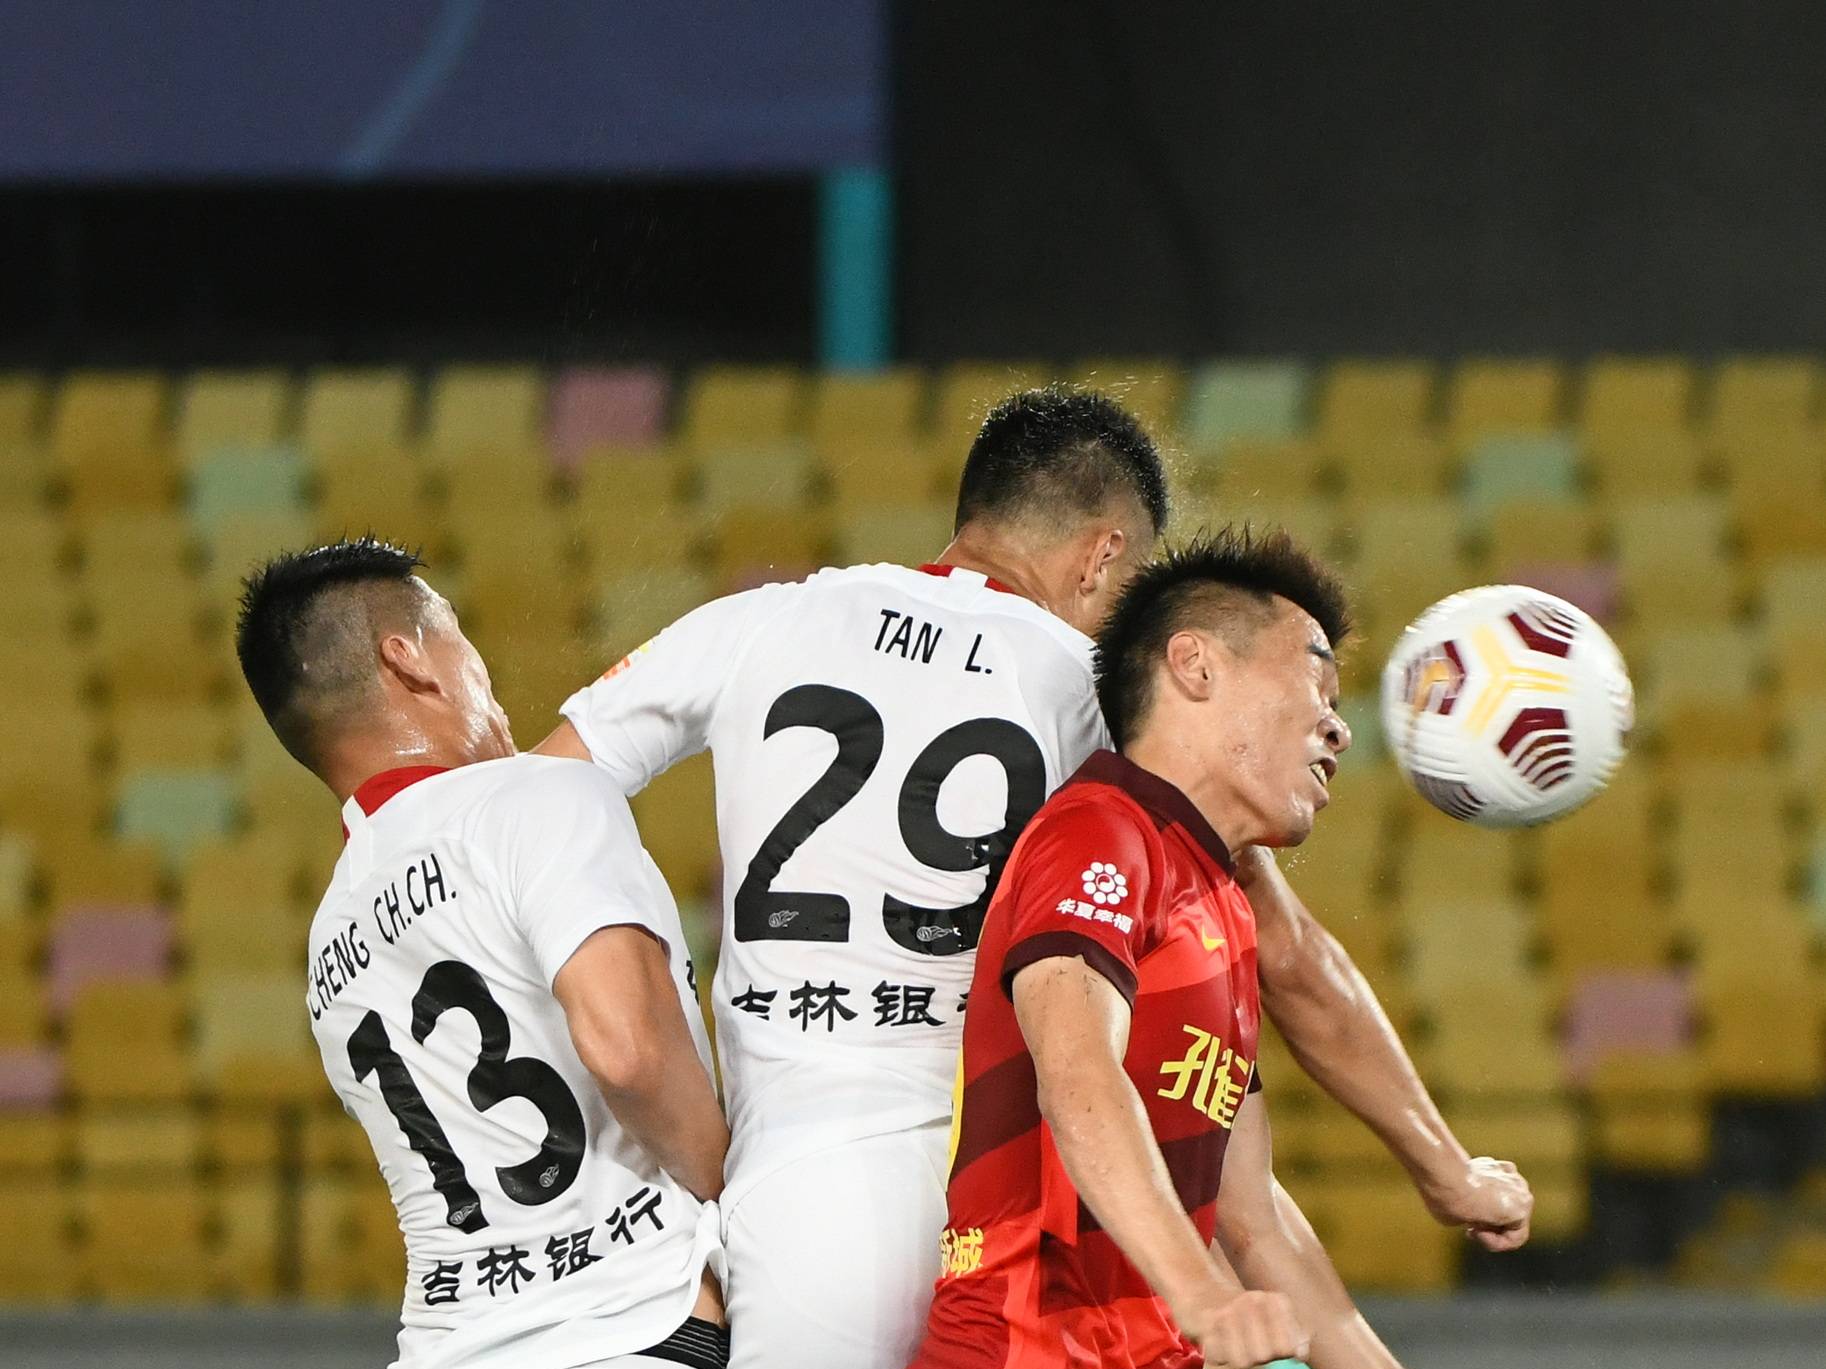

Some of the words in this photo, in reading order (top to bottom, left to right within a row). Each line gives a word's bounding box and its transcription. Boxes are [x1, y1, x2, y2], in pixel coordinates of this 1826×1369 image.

[874, 609, 942, 664] TAN
[965, 633, 993, 675] L.
[734, 684, 1047, 956] 29
[310, 921, 370, 1021] CHENG
[374, 853, 457, 945] CH.CH.
[347, 960, 587, 1235] 13
[421, 1186, 665, 1306] 吉林银行
